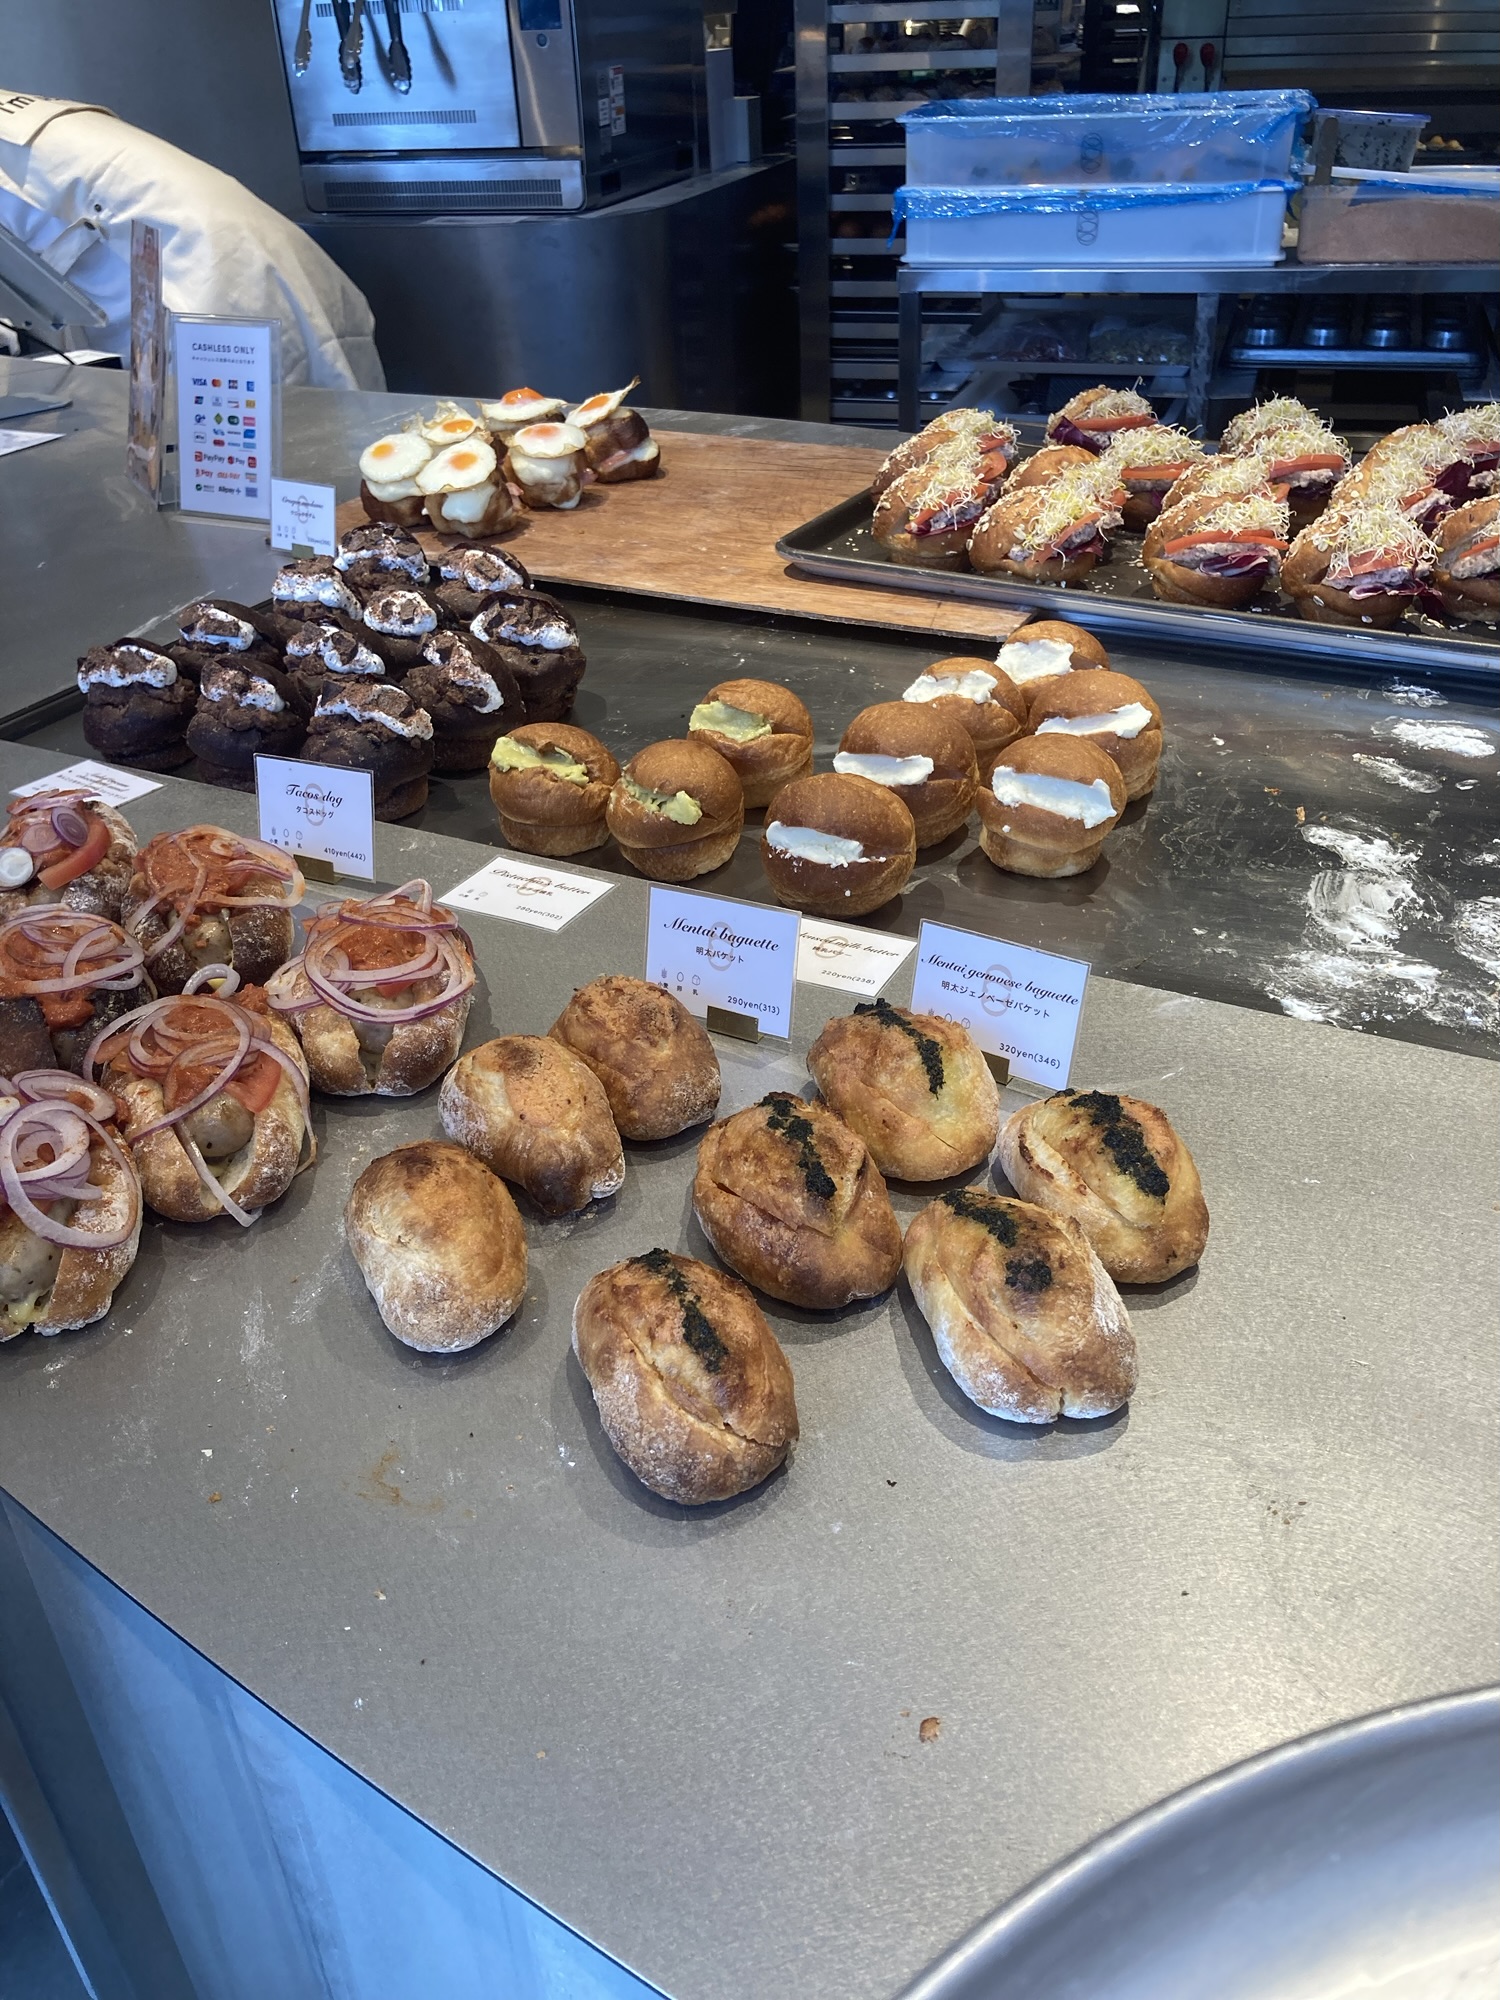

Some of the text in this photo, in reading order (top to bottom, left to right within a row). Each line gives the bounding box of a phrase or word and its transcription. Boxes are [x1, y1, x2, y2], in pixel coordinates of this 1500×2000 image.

[192, 343, 255, 354] CASHLESS ONLY
[192, 378, 207, 386] VISA
[285, 784, 343, 808] Tacos dog
[296, 806, 334, 818] タコスドッグ
[324, 847, 366, 861] 410yen(442)
[554, 883, 591, 895] butter
[516, 905, 563, 920] 280yen(302)
[663, 917, 780, 952] Mentai baguette
[695, 946, 744, 963] 明太バケット
[863, 946, 899, 957] butter
[821, 969, 876, 985] 220yen(238)
[921, 954, 1079, 1006] Mentai genovese baguette
[727, 995, 780, 1015] 290yen(313)
[941, 980, 1050, 1019] 明太ジェノベーゼバケット
[999, 1042, 1061, 1069] 320yen(346)
